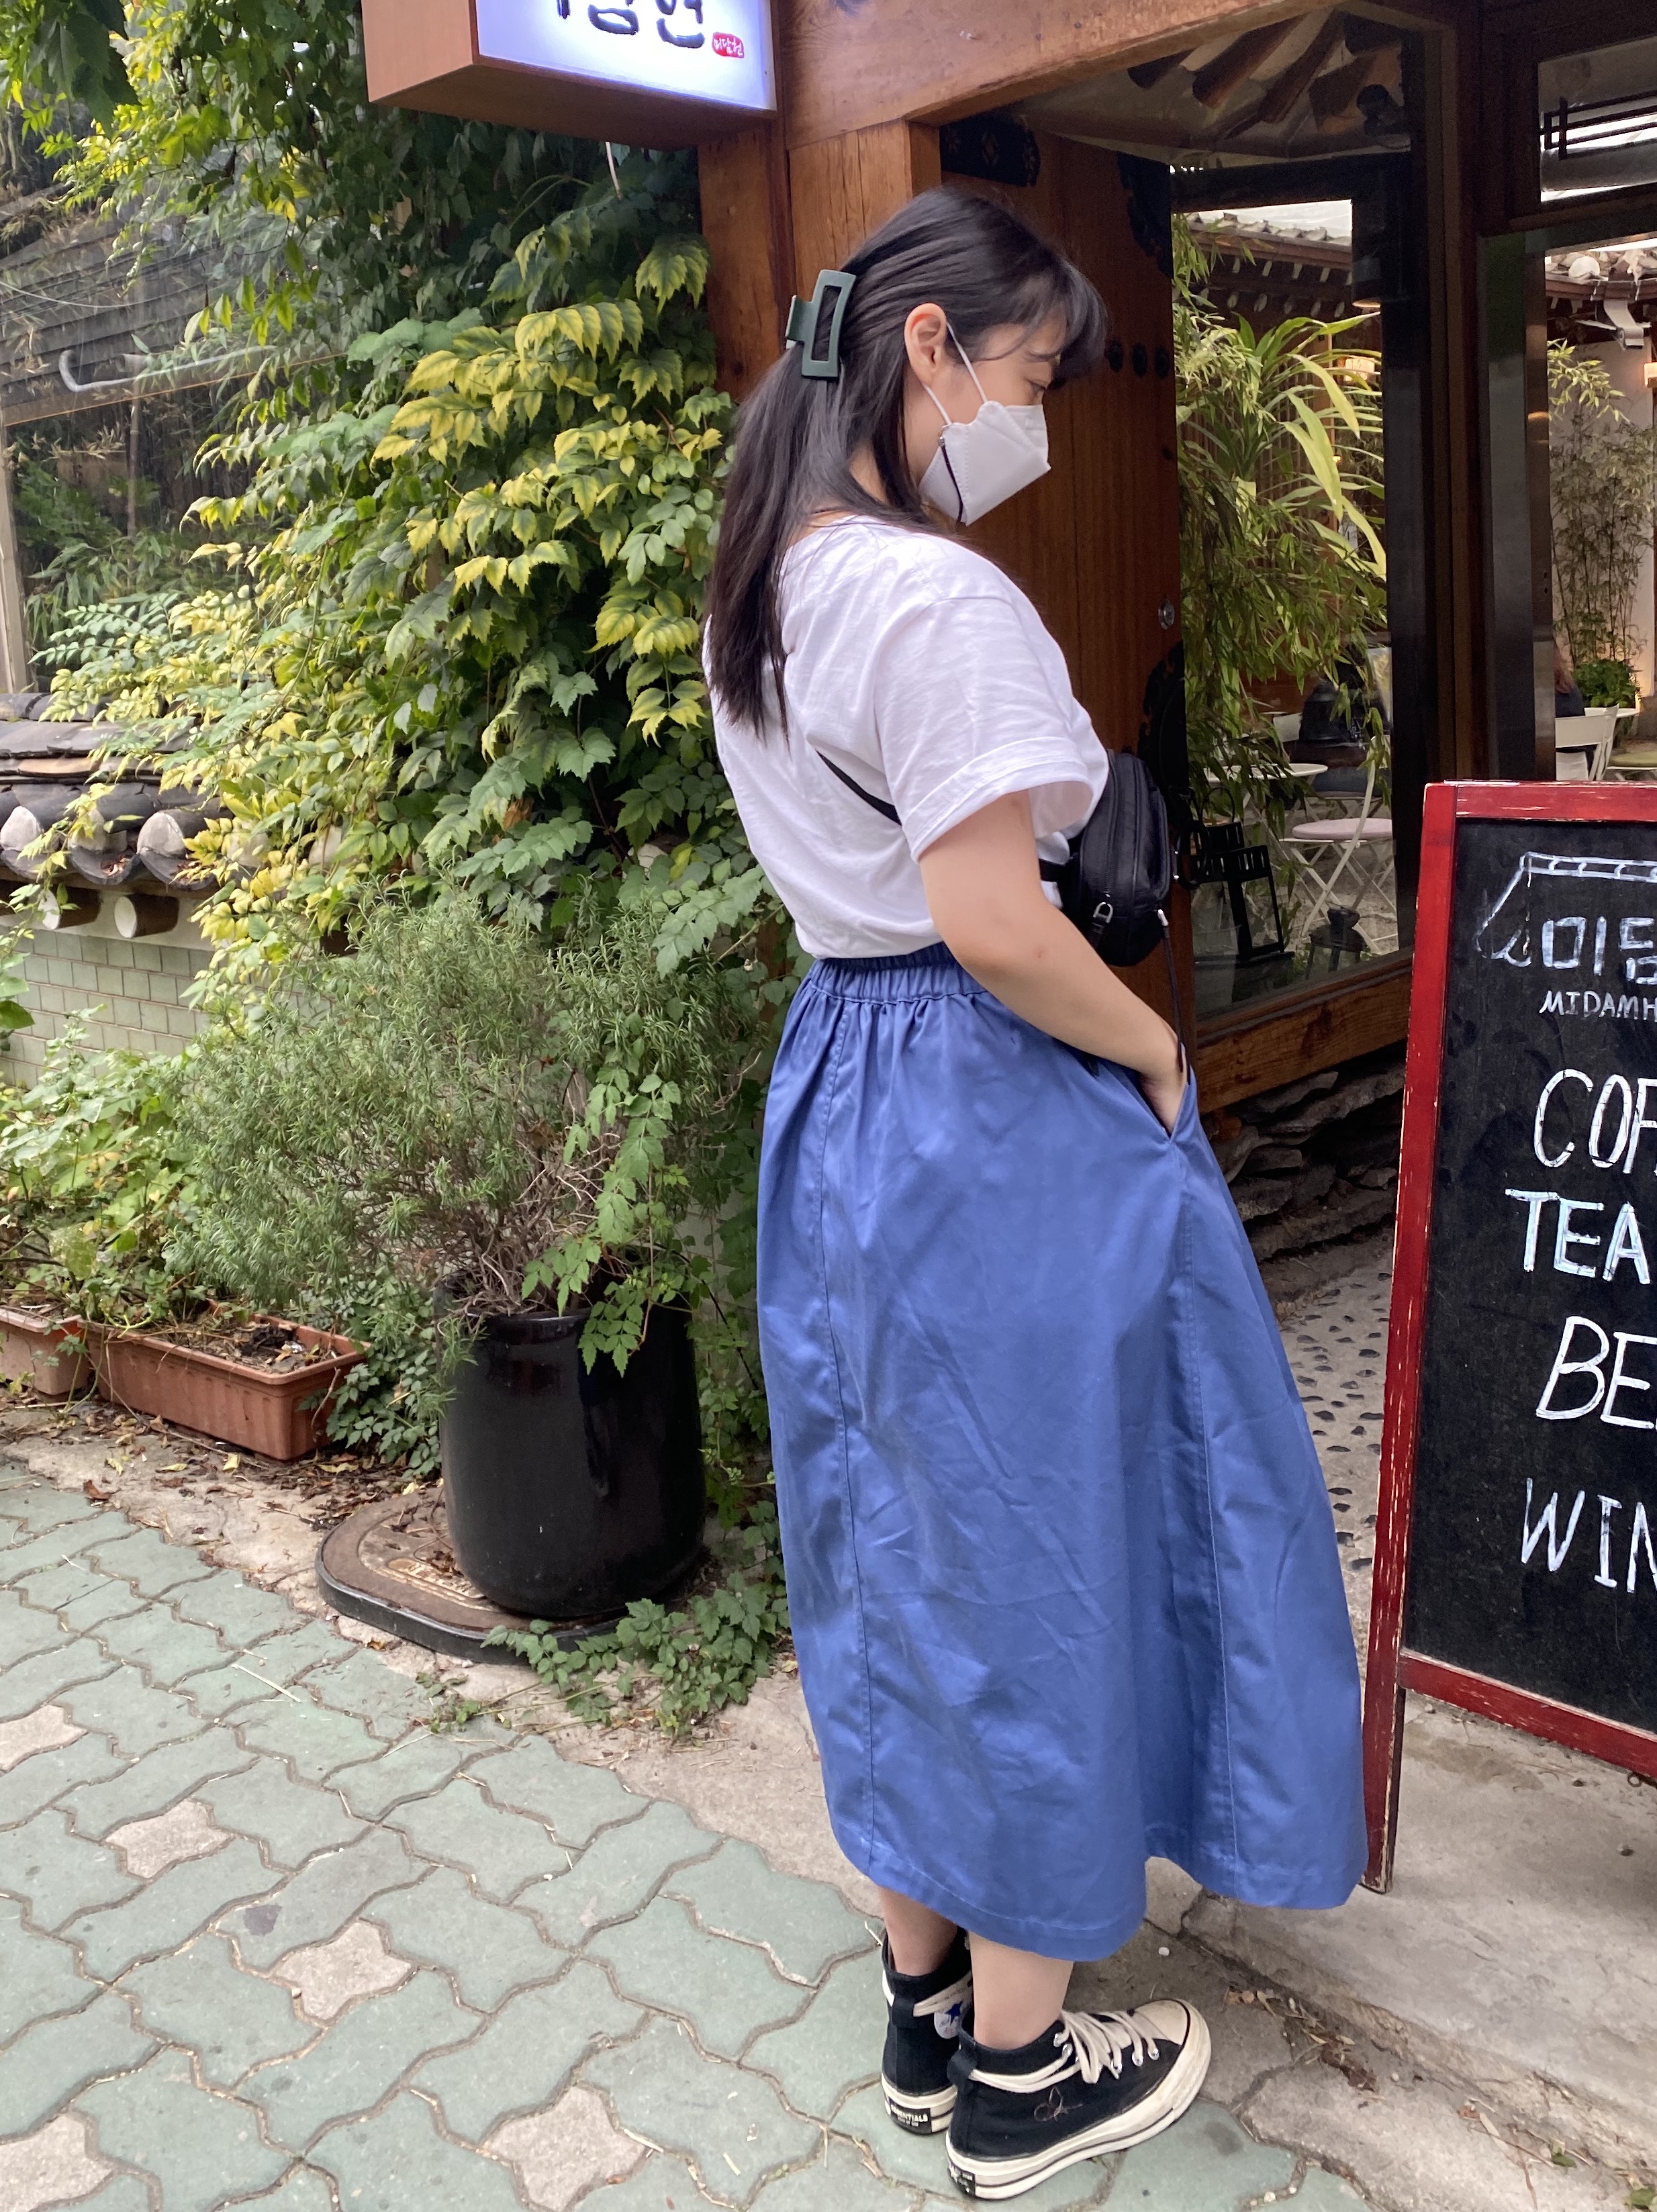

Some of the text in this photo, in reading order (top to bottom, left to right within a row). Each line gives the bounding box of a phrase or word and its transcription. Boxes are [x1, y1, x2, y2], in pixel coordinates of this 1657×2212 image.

[1533, 1069, 1657, 1176] COF
[1505, 1188, 1651, 1285] TEA
[1535, 1316, 1657, 1432] BE
[1521, 1478, 1657, 1594] WIN
